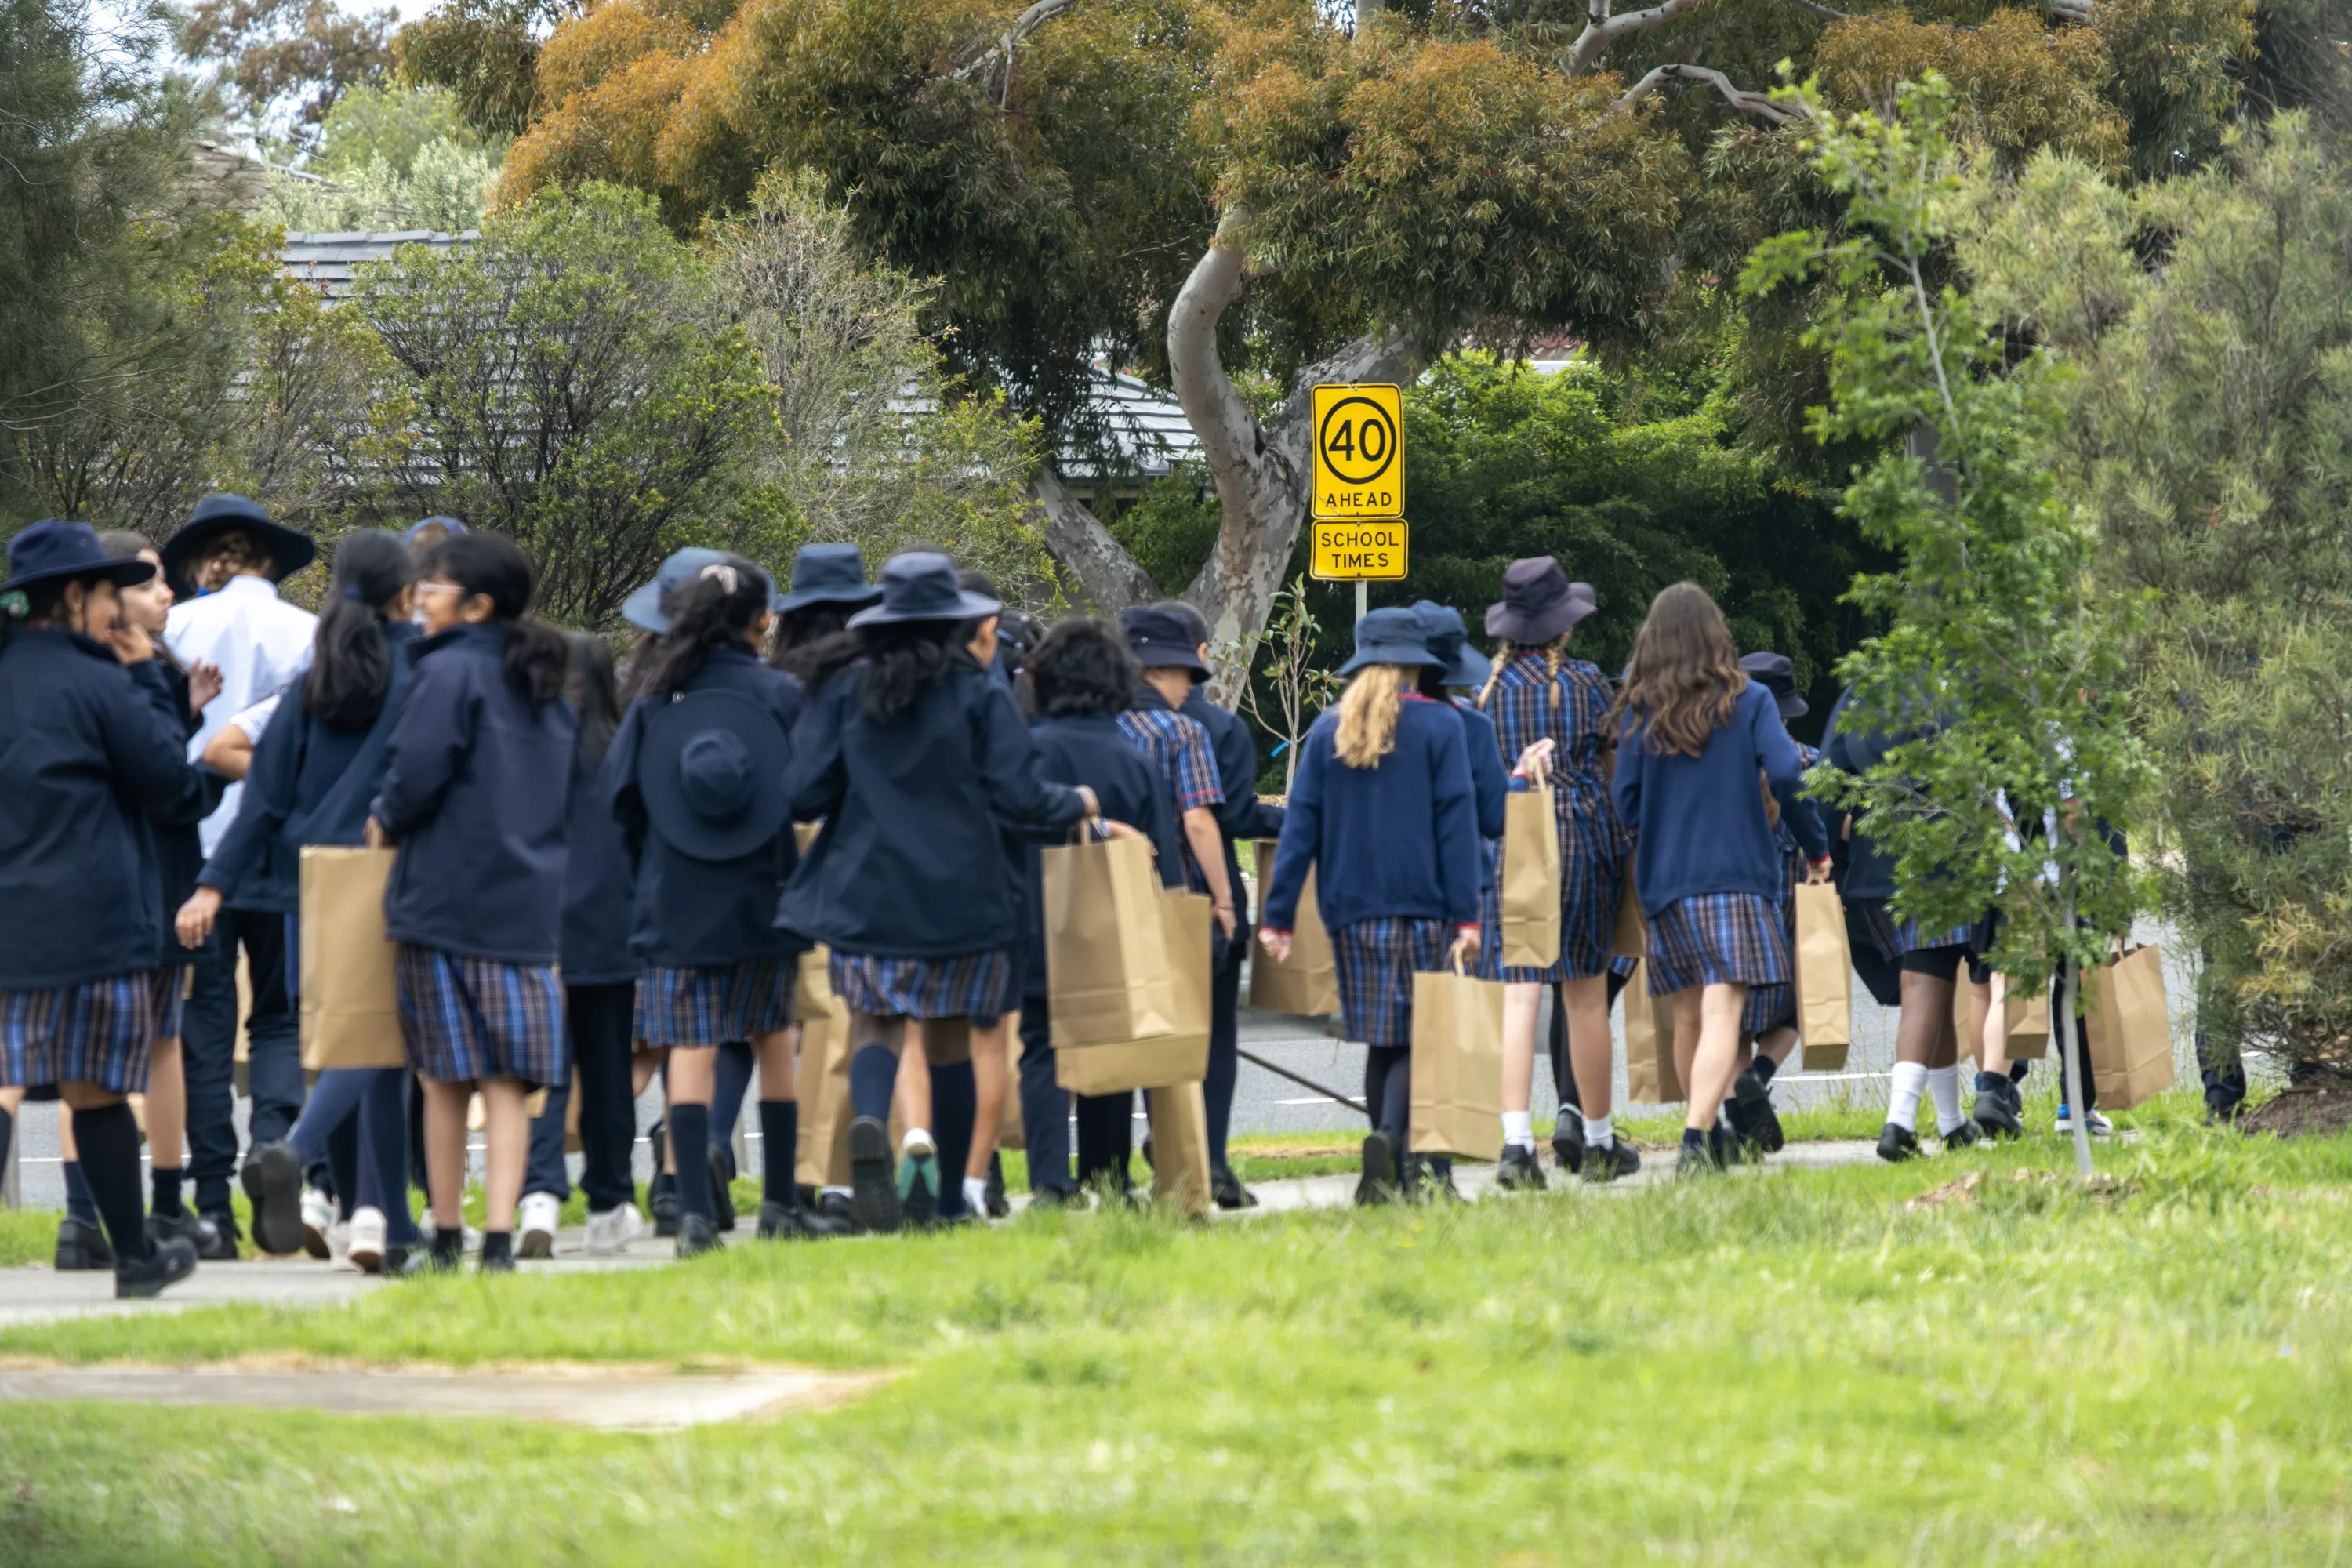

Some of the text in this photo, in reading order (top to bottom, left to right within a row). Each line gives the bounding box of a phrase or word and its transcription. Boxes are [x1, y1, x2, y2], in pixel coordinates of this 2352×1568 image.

[1328, 419, 1385, 462] 40
[1325, 492, 1392, 507] AHEAD
[1321, 532, 1399, 547] SCHOOL
[1332, 553, 1389, 568] TIMES
